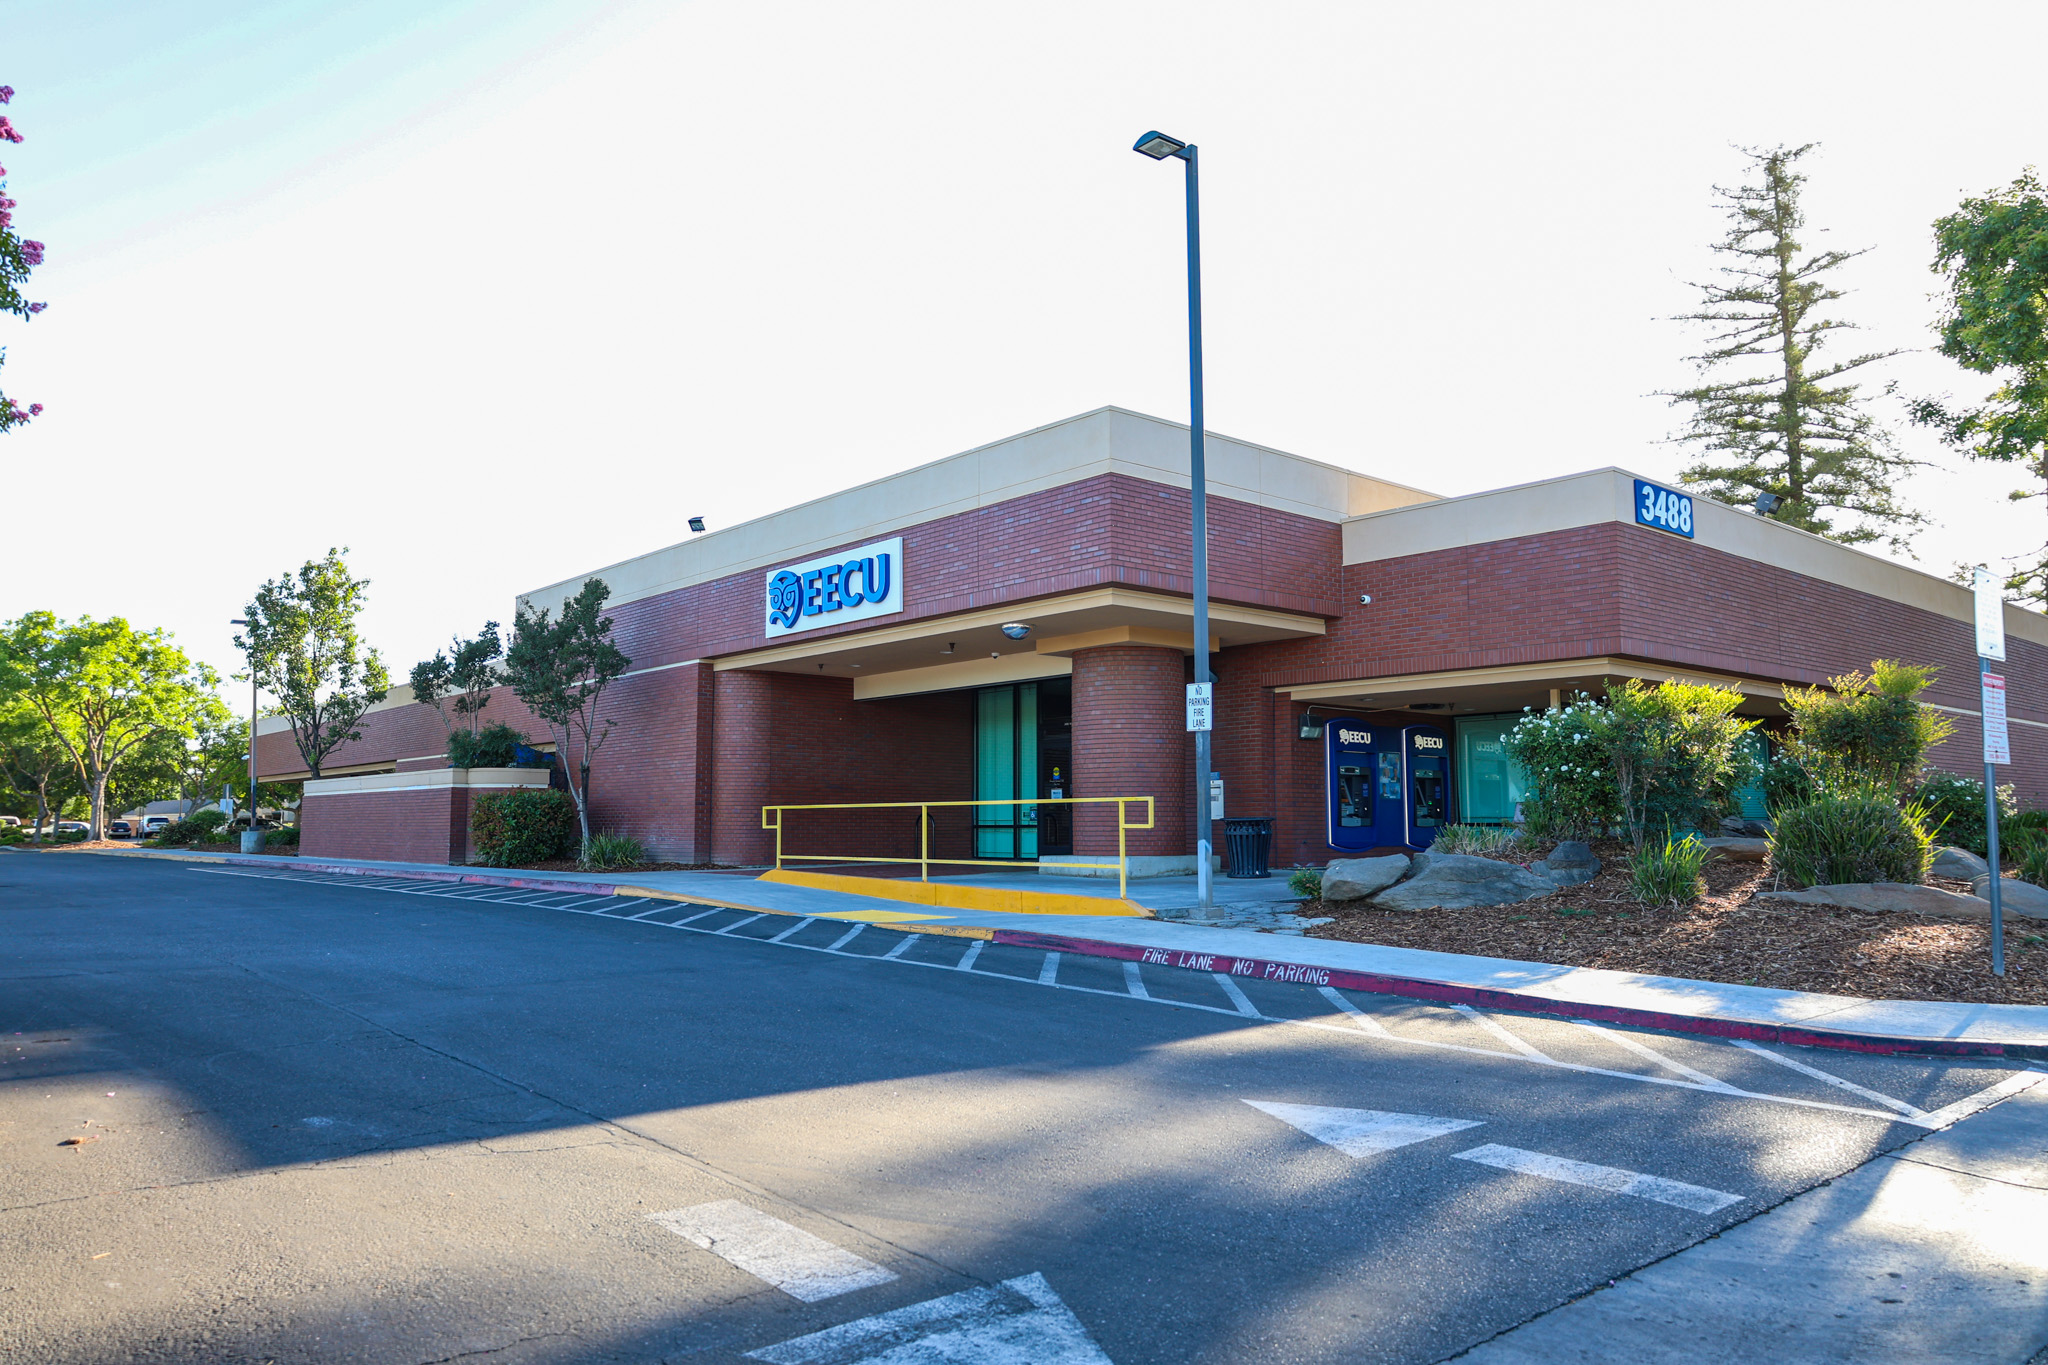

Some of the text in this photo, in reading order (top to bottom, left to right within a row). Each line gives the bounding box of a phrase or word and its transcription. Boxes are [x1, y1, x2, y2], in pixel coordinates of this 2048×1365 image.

[1641, 485, 1691, 533] 3488
[801, 553, 890, 616] EECU
[1195, 686, 1203, 696] NO
[1188, 697, 1210, 706] PARKING
[1193, 708, 1205, 717] FIRE
[1192, 718, 1206, 728] LANE
[1349, 731, 1371, 744] EECU
[1423, 737, 1443, 749] EECU
[1141, 948, 1330, 986] FIRE LANE NO PARKING
